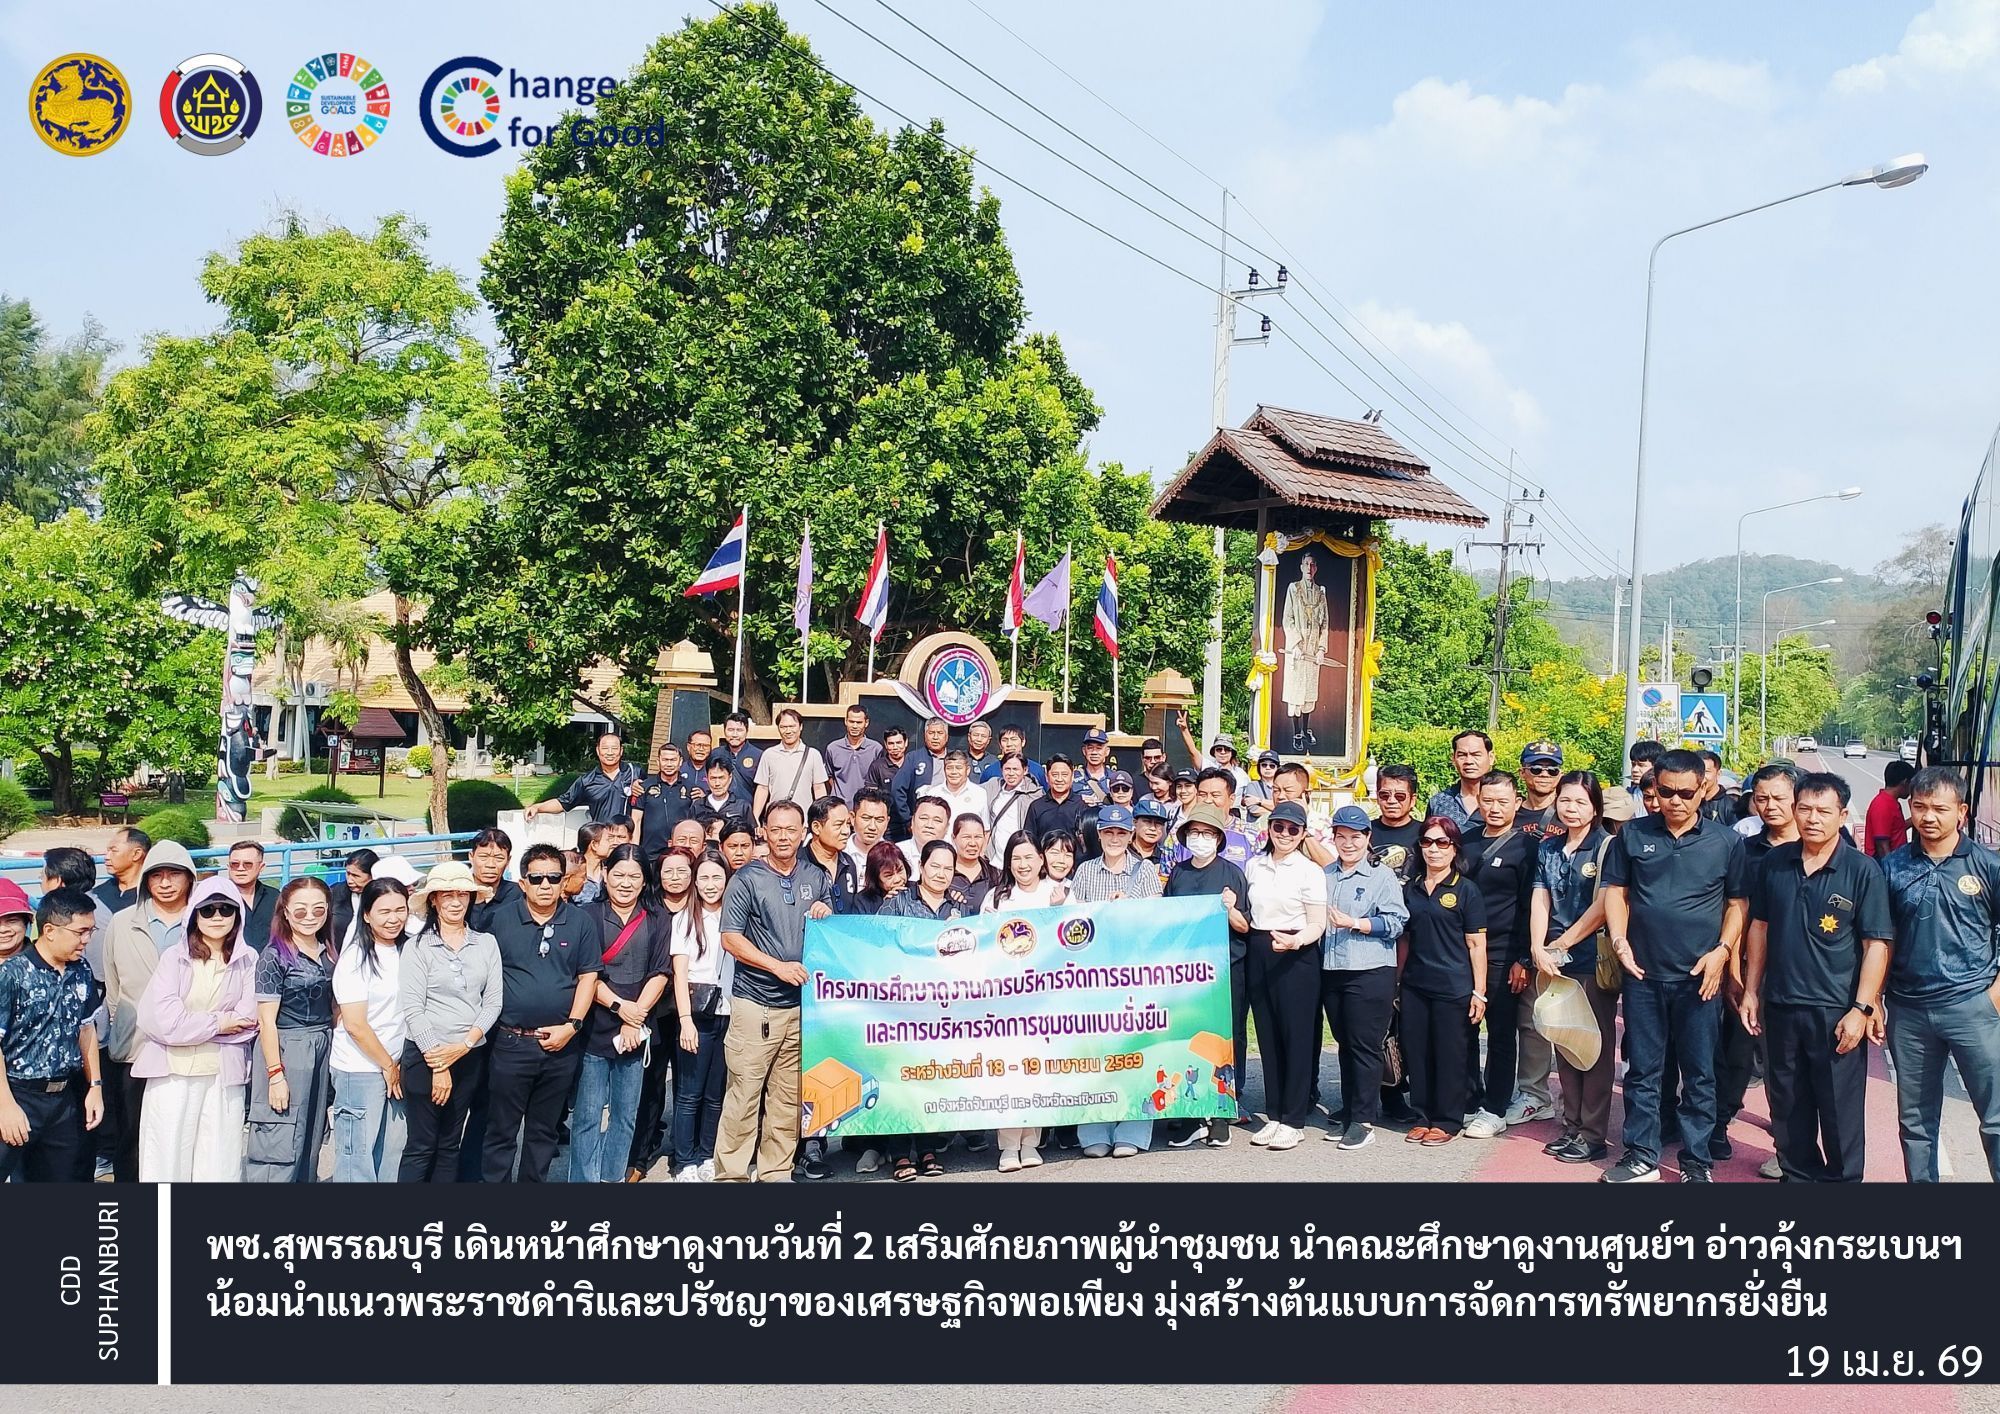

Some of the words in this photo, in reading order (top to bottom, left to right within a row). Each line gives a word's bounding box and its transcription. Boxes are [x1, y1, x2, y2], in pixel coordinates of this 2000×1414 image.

[915, 762, 926, 776] 3
[816, 962, 1214, 1009] โครงการศึกษาดูงานการบริหารจัดการธนาคารขยะ
[866, 997, 1168, 1043] และการบริหารจัดการชุมชนแบบยั่งยืน
[901, 1053, 983, 1080] ระหว่างวันที่
[986, 1060, 1005, 1077] 18
[1023, 1058, 1041, 1074] 19
[1045, 1056, 1100, 1074] เมษายน
[1104, 1053, 1143, 1071] 2569
[924, 1102, 937, 1113] ณ
[939, 1094, 1008, 1113] จังหวัดจันทบุรี
[1010, 1099, 1030, 1109] และ
[1033, 1091, 1117, 1109] จังหวัดฉะเชิงเทรา
